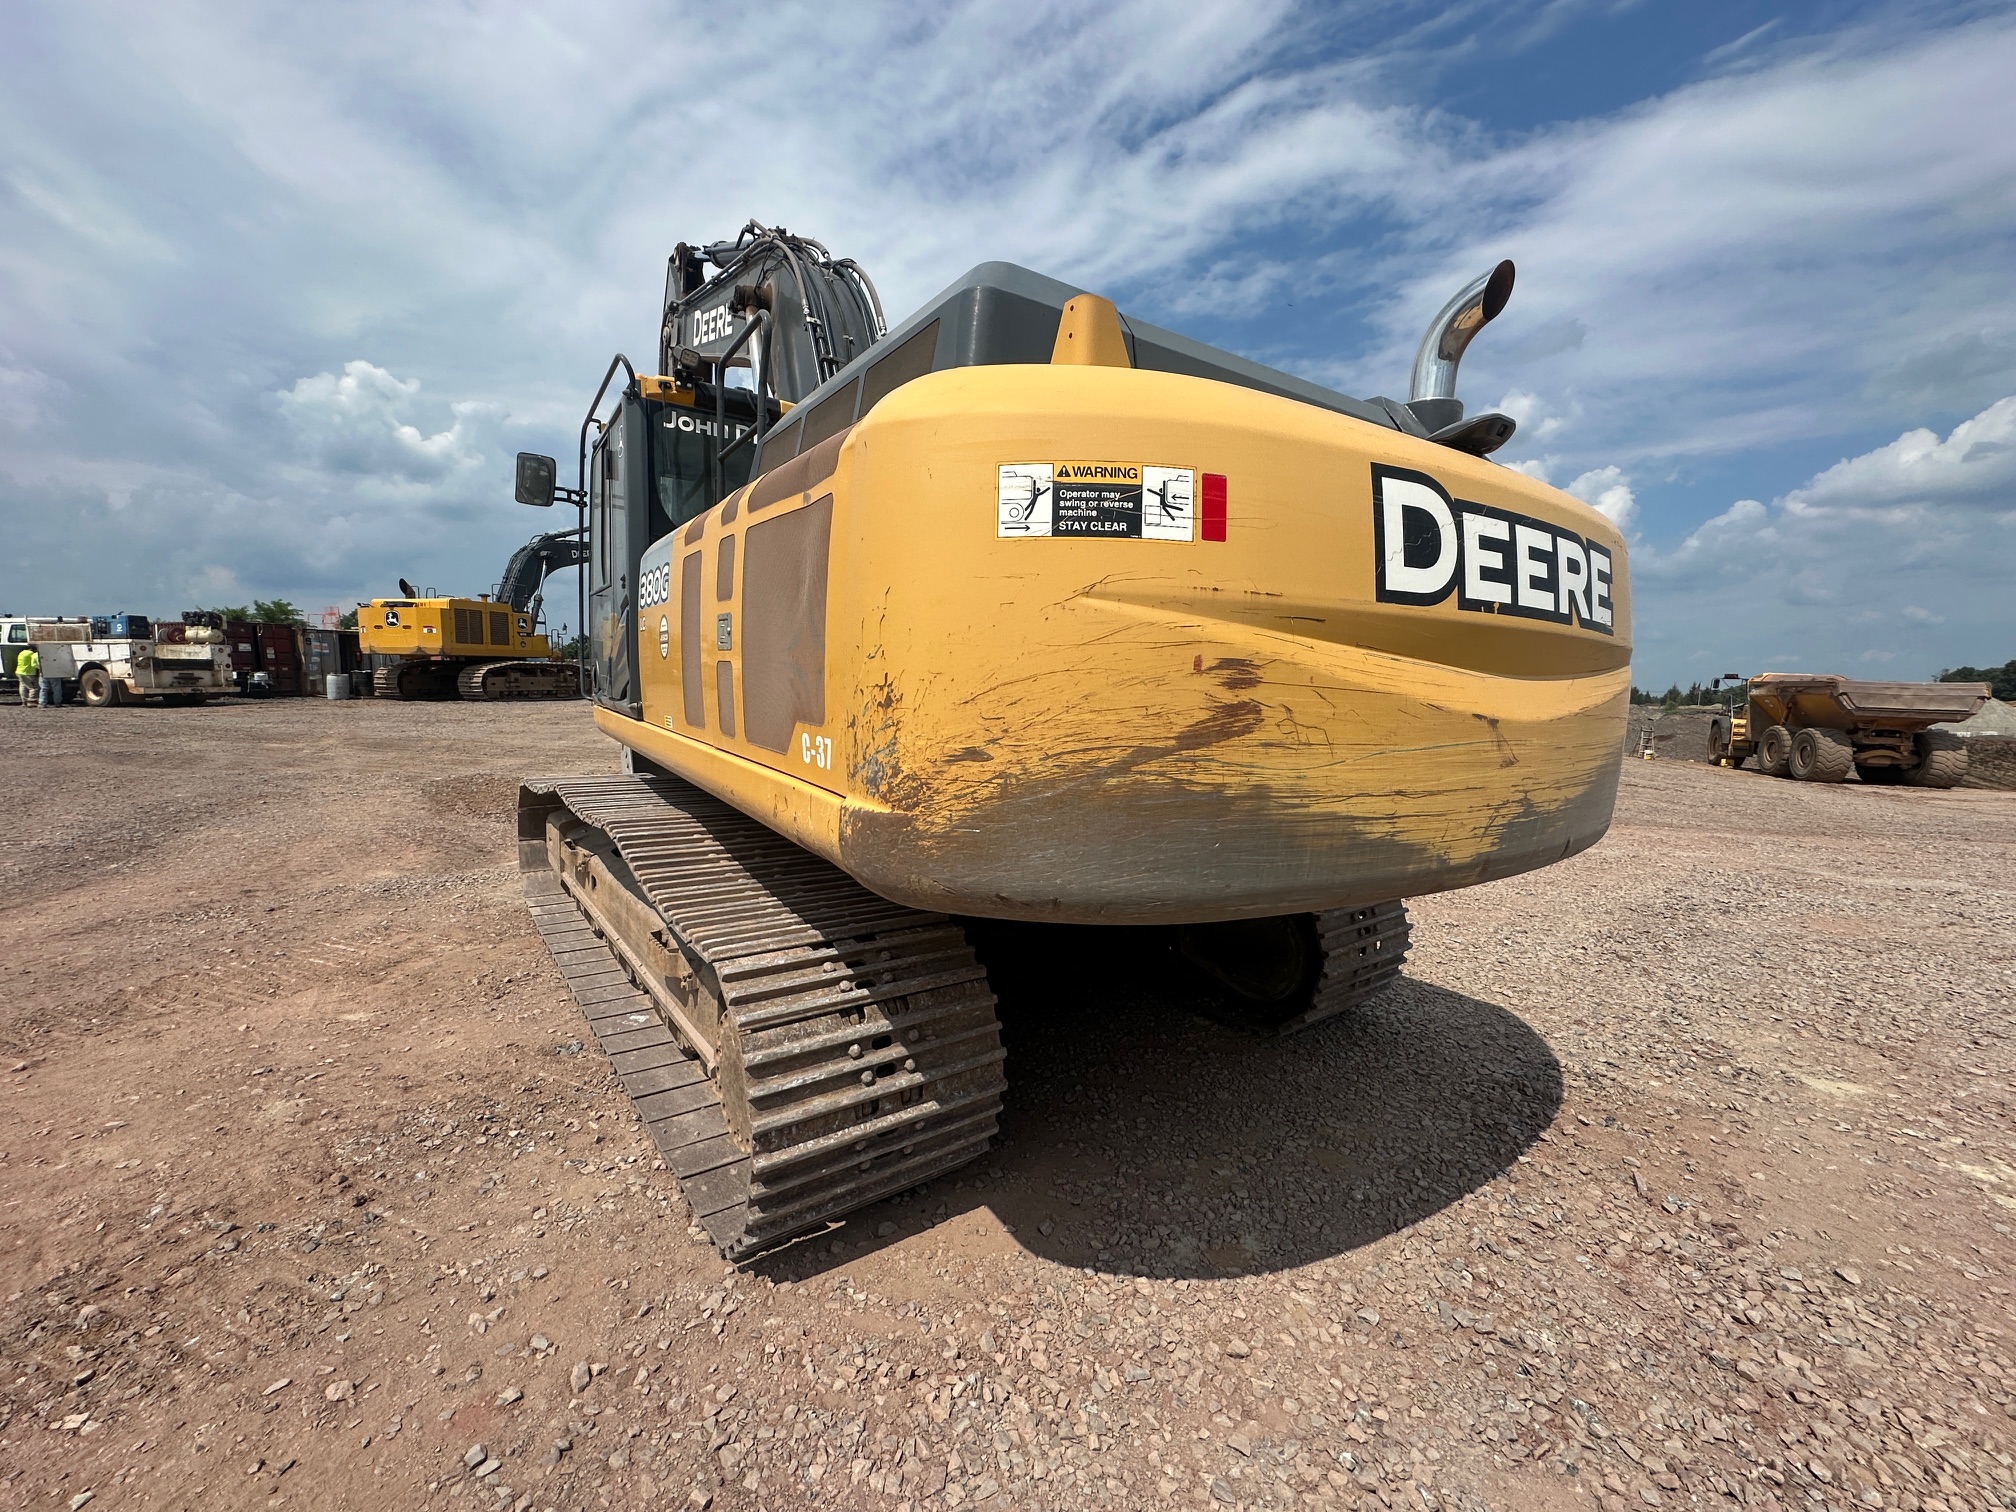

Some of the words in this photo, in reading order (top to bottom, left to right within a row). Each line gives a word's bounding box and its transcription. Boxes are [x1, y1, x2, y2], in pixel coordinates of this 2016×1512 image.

[693, 302, 733, 347] DEERE
[1072, 466, 1138, 480] WARNING
[1059, 489, 1099, 500] Operator
[1101, 491, 1121, 501] may
[1059, 499, 1087, 509] swing
[1100, 501, 1134, 509] reverse
[1059, 509, 1098, 517] machine
[1058, 521, 1088, 531] STAY
[1090, 521, 1127, 532] CLEAR
[1380, 476, 1613, 628] DEERE
[640, 564, 670, 608] 380G
[801, 732, 832, 771] C-37
